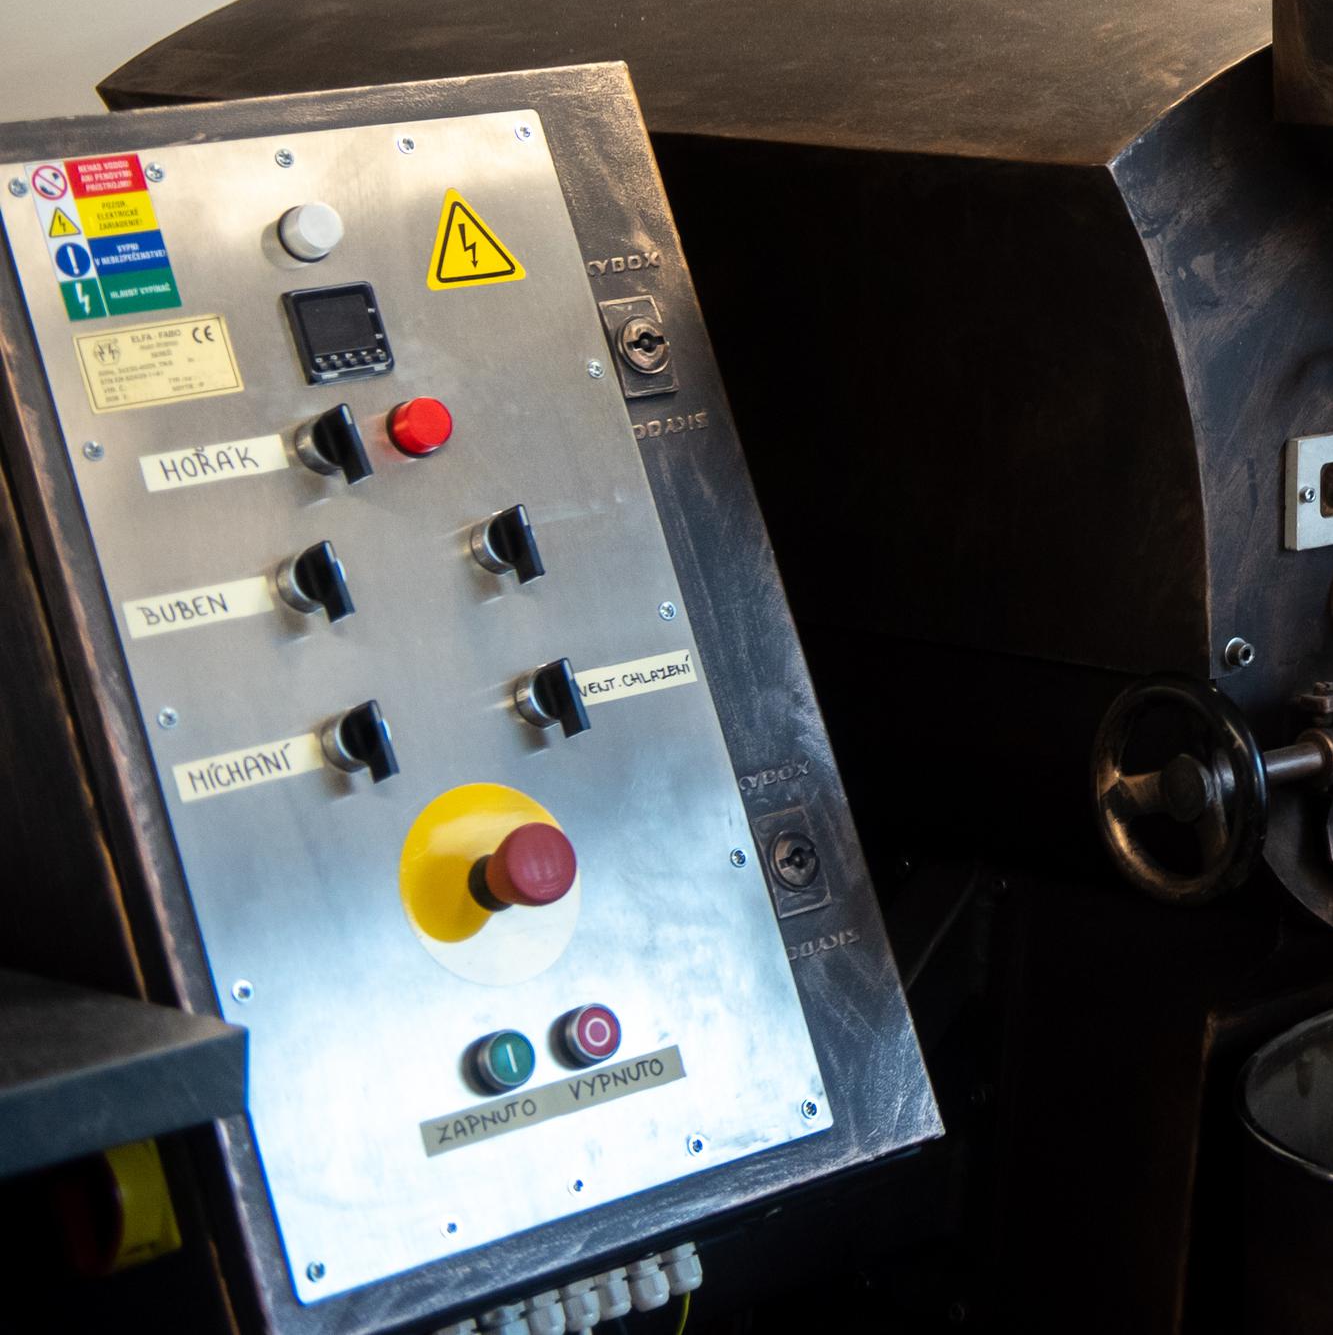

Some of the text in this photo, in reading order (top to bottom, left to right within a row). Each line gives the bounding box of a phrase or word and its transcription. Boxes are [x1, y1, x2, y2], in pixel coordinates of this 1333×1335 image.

[158, 444, 260, 483] HOŘÁK
[136, 592, 230, 627] BUBEN
[436, 1056, 665, 1145] ZAPNUTO VYPNUTO
